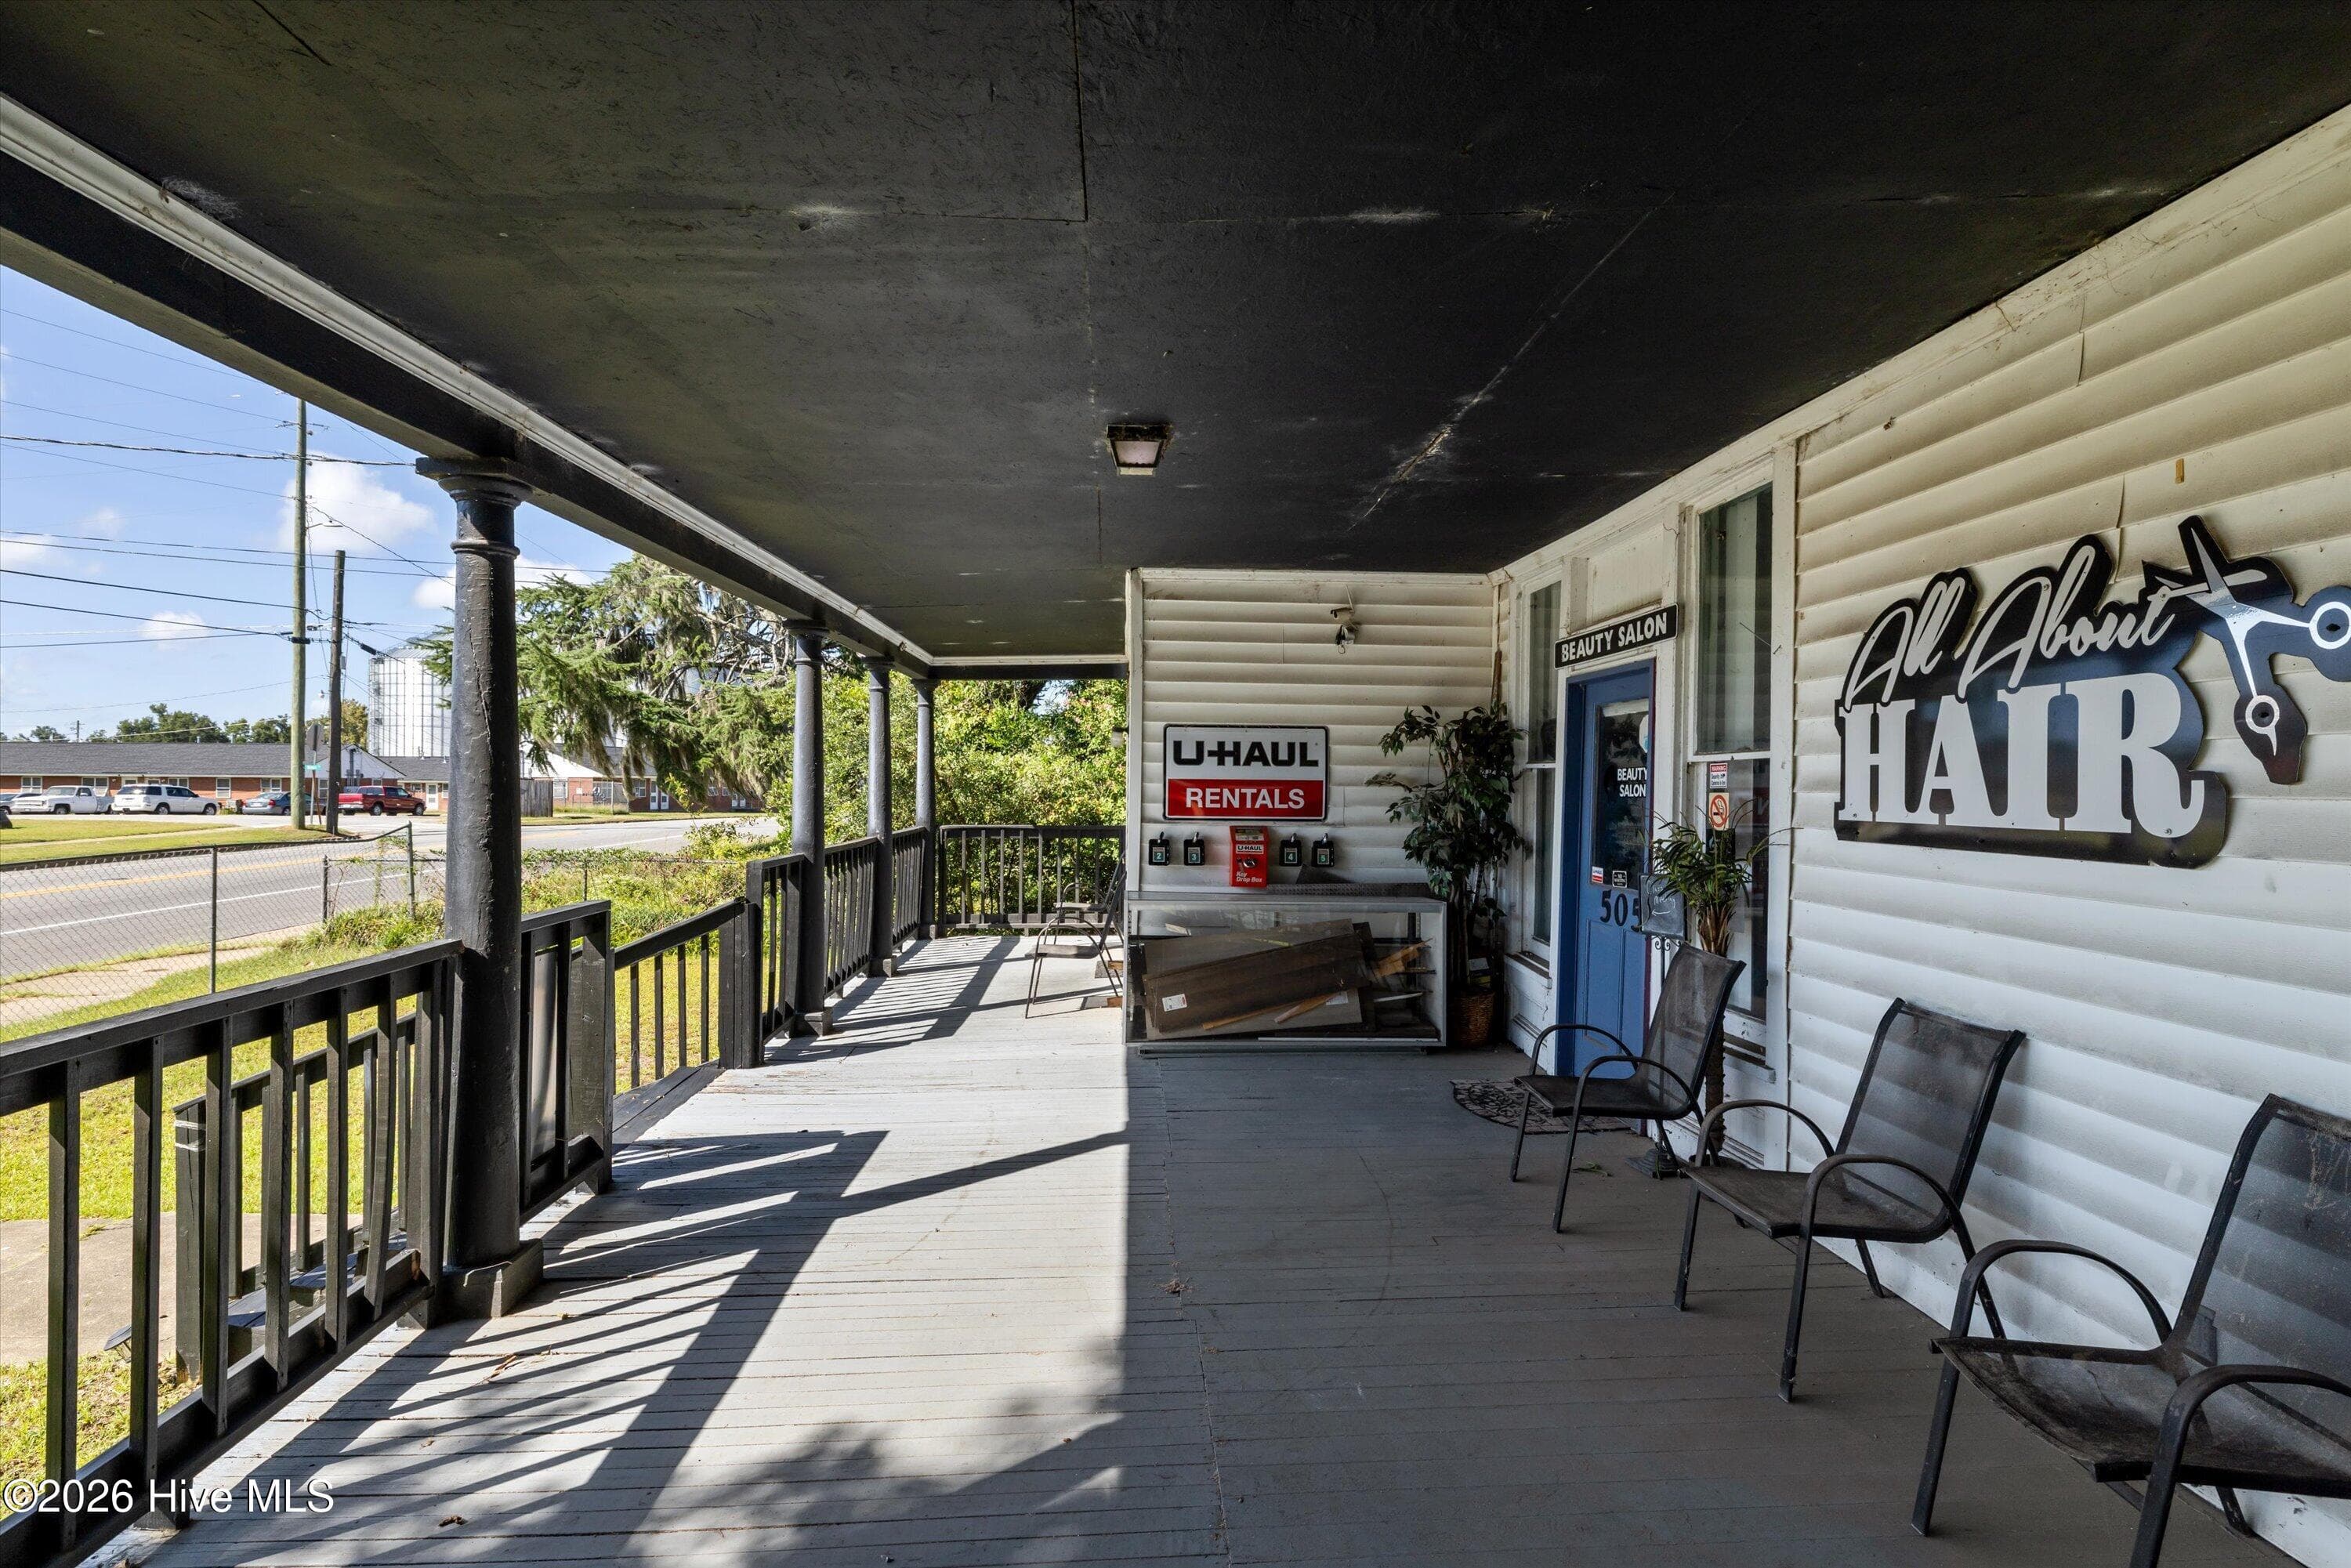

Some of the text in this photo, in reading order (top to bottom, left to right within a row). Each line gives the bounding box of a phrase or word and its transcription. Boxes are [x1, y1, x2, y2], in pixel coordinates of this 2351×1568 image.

[1561, 612, 1667, 662] BEAUTY SALON
[1844, 545, 2174, 711] All About
[1172, 740, 1320, 767] U-HAUL
[1838, 672, 2205, 838] HAIR
[1617, 766, 1648, 782] BEAUTY
[1186, 788, 1305, 809] RENTALS
[1619, 784, 1646, 798] SALON
